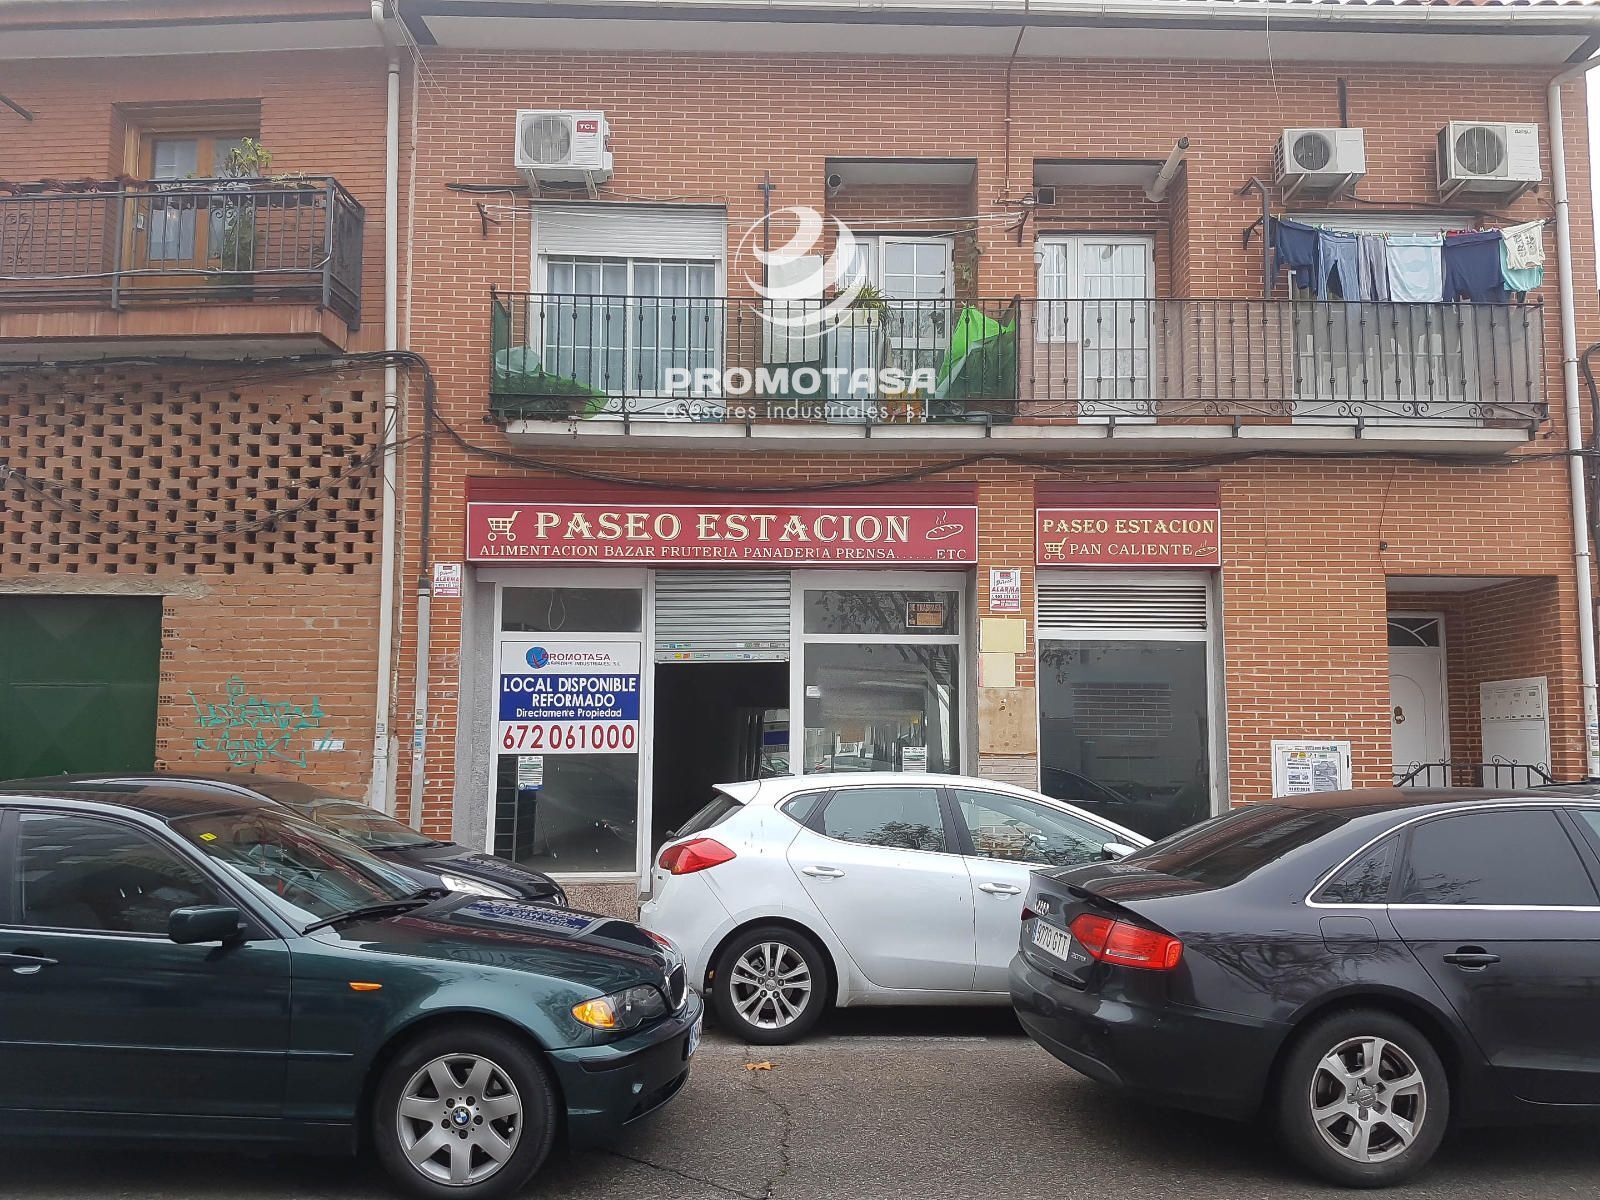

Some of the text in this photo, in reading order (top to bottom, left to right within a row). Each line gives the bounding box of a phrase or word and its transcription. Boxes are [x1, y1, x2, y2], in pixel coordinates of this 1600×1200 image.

[534, 511, 911, 543] PASEO ESTACION
[1042, 519, 1215, 535] PASEO ESTACION
[479, 545, 598, 557] ALIMENTACION
[604, 546, 655, 557] BAZAR
[661, 546, 738, 558] FRUTERIA
[743, 547, 831, 559] PANADERIA
[936, 549, 967, 560] ETC
[1069, 543, 1193, 556] PAN CALIENTE
[542, 653, 611, 661] PROMOTASA
[503, 677, 637, 692] LOCAL DISPONIBLE
[532, 693, 616, 707] REFORMADO
[516, 708, 622, 719] Directamente Propiedad
